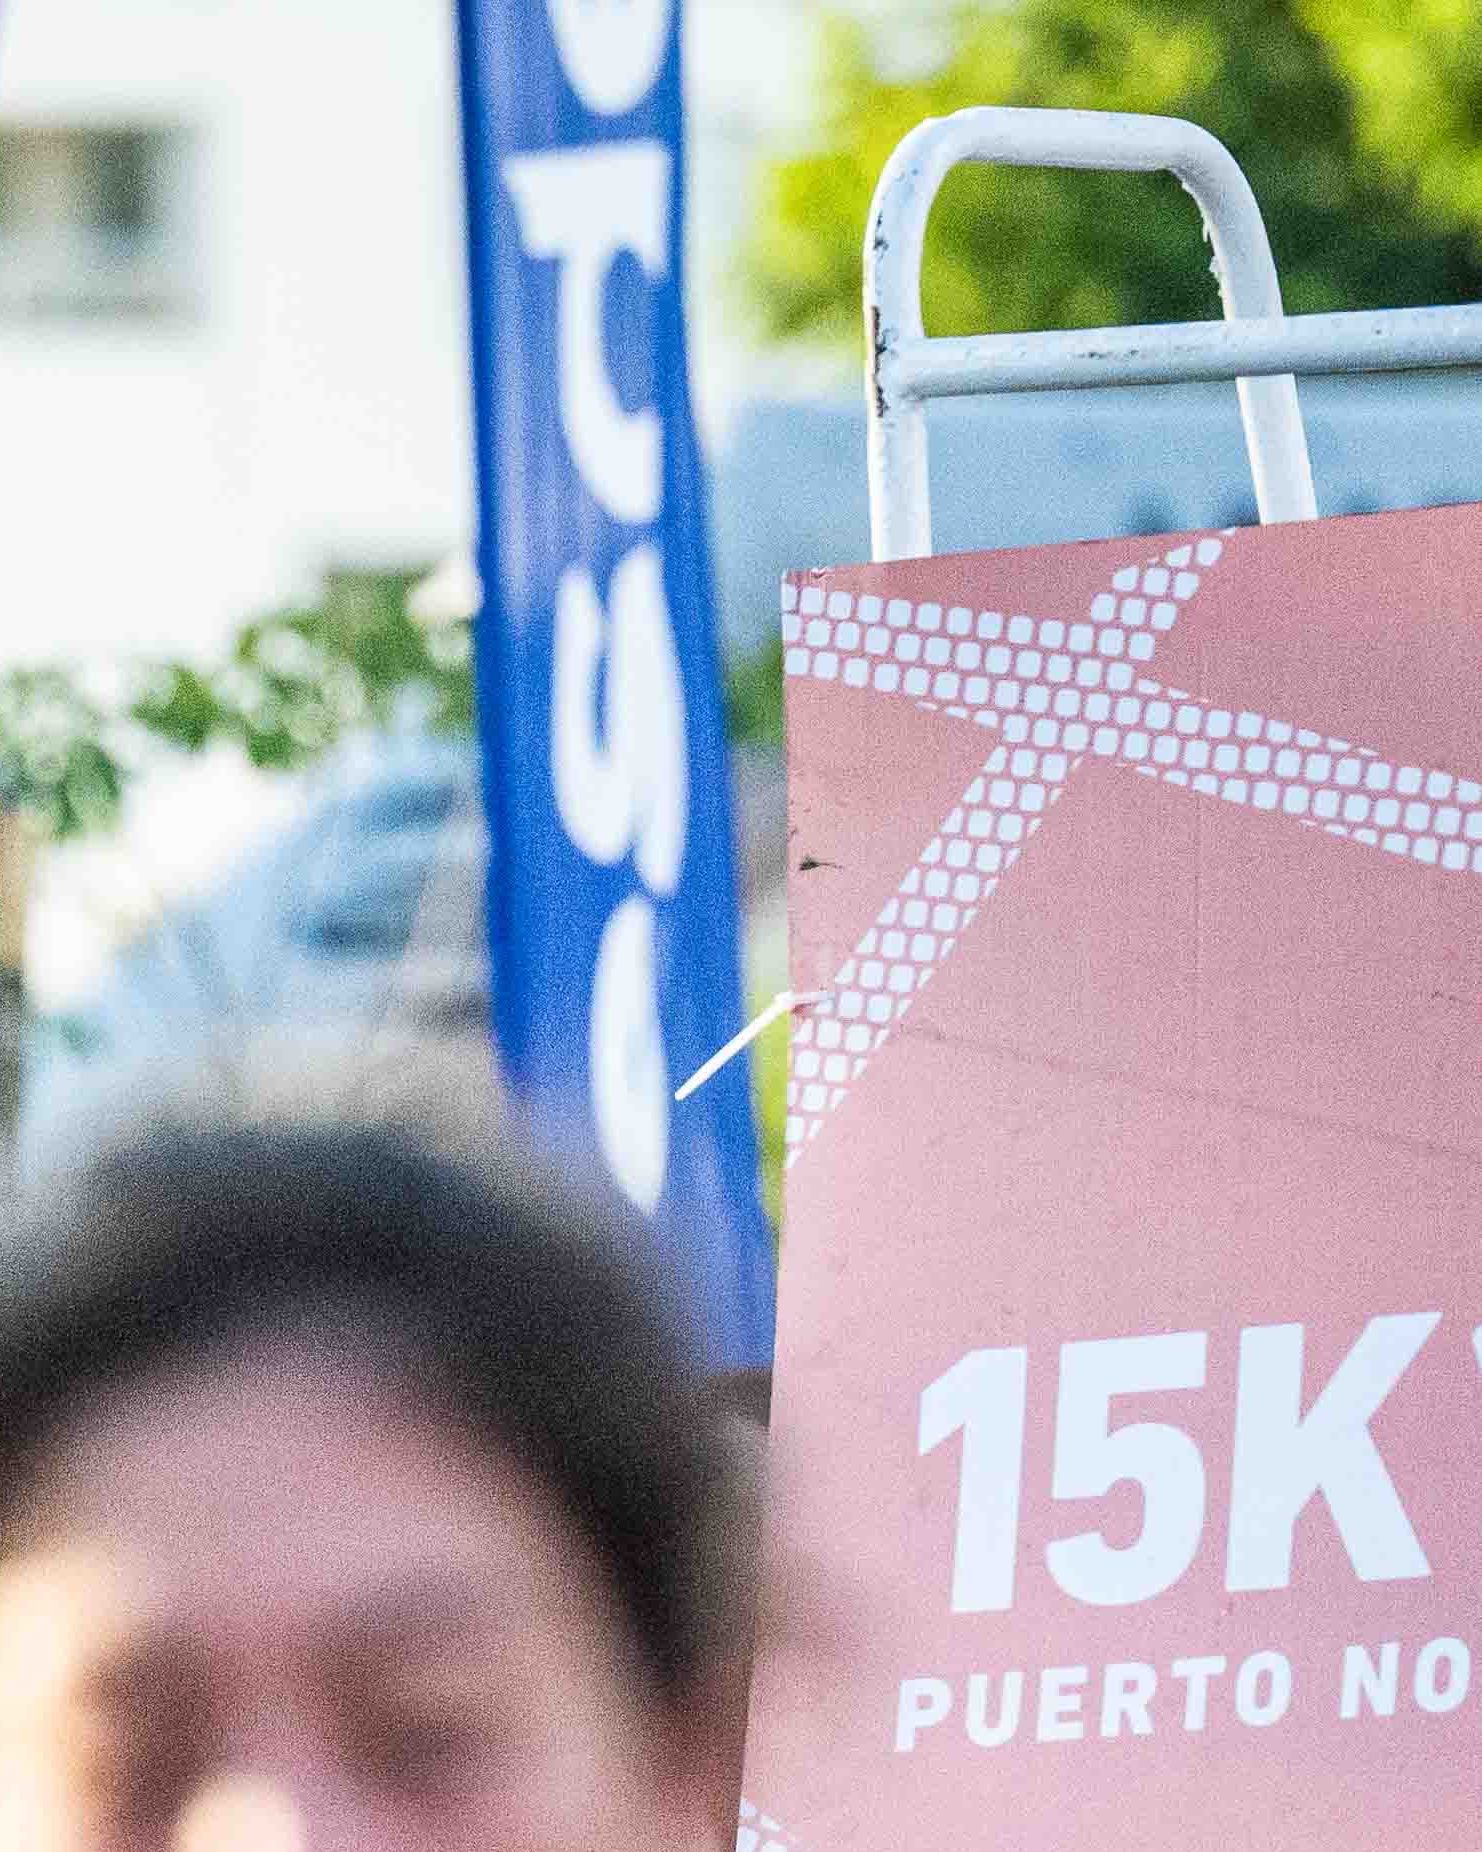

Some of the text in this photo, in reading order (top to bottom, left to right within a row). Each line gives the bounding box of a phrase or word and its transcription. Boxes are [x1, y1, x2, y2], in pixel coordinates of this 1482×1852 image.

[917, 1311, 1444, 1613] 15K
[894, 1636, 1471, 1753] PUERTO NO
